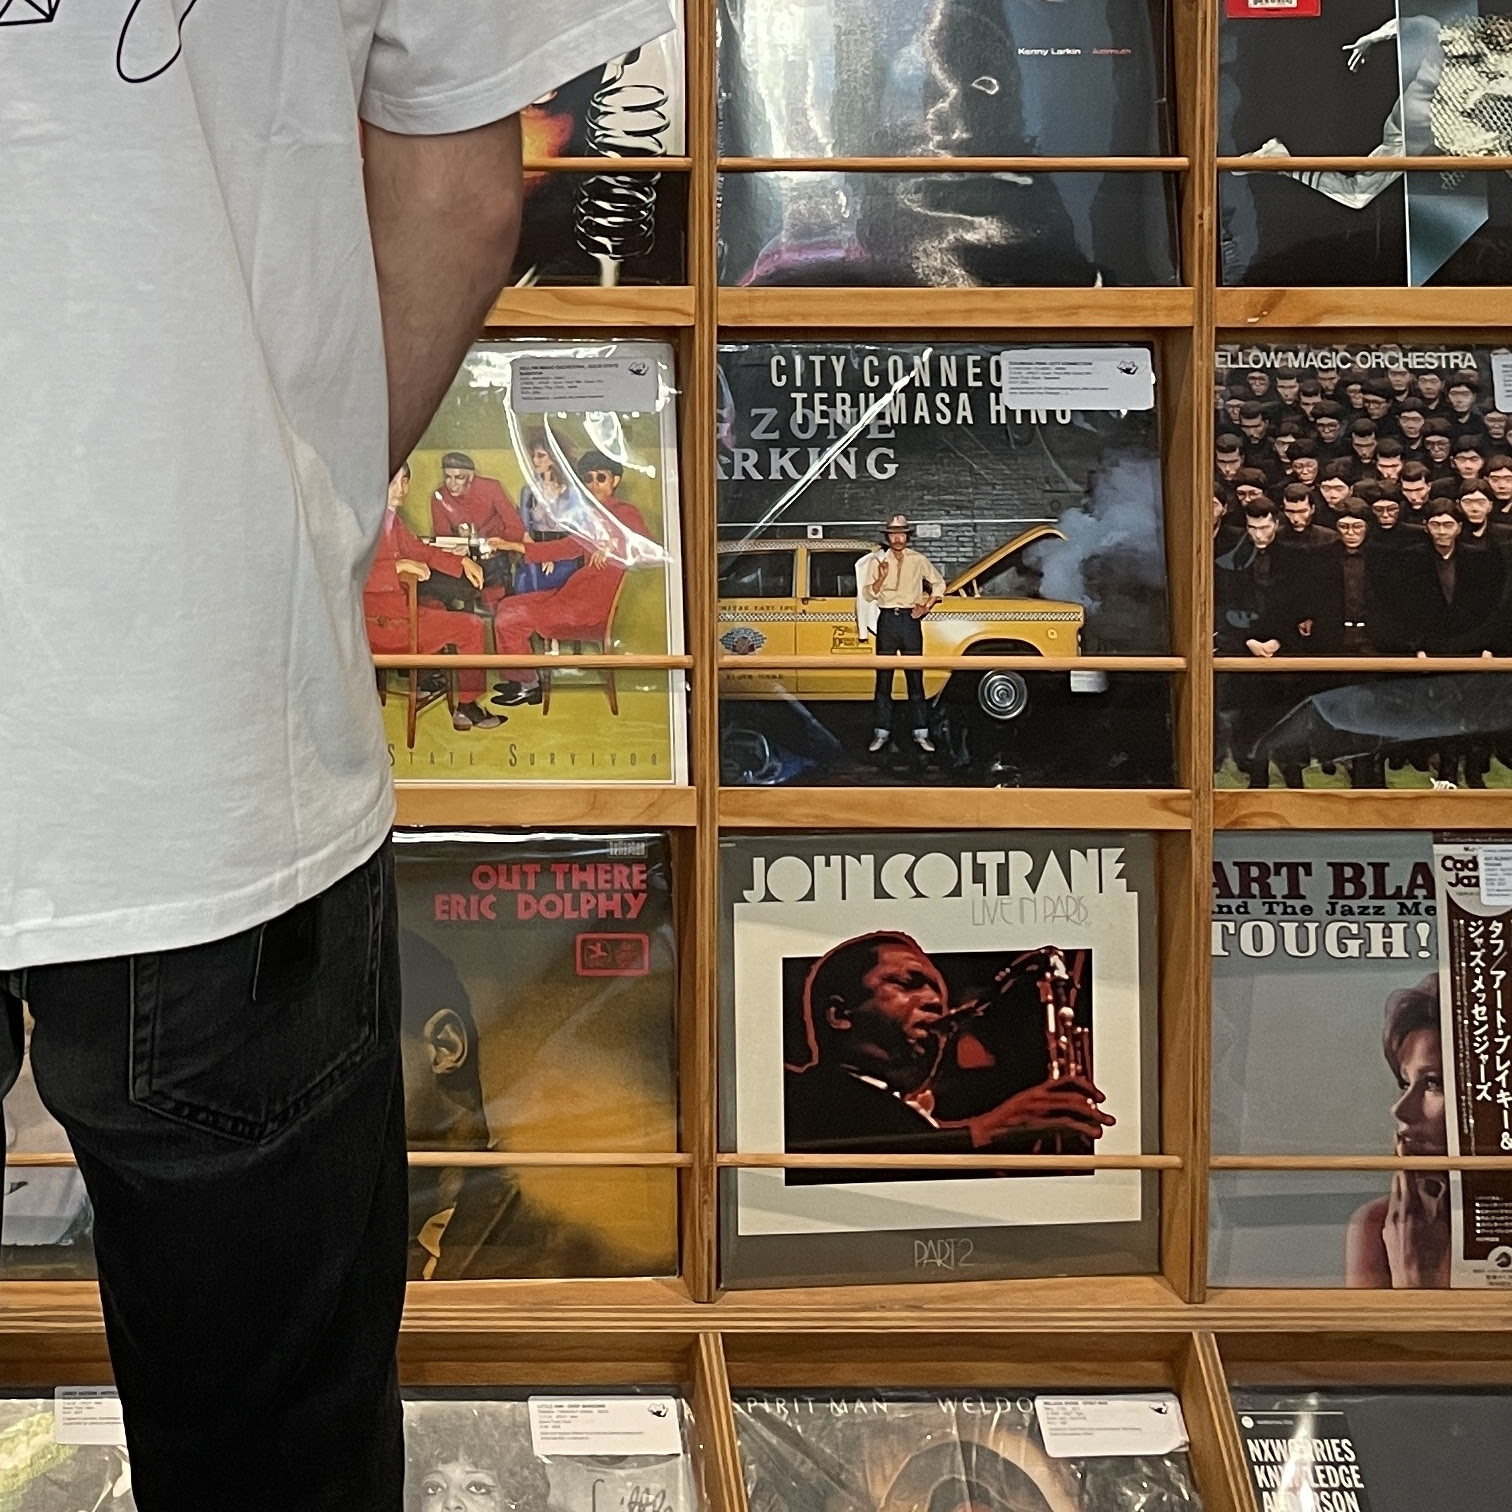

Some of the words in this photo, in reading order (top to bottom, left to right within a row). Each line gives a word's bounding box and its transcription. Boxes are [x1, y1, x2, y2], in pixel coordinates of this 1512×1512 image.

[1017, 48, 1048, 56] Kenny
[770, 355, 847, 387] CITY
[1297, 351, 1352, 369] MAGIC
[1355, 350, 1477, 369] ORCHESTRA
[471, 864, 541, 891] OUT
[550, 863, 647, 890] THERE
[742, 854, 875, 903] JOHN
[880, 847, 1127, 900] COLTRANE
[434, 893, 497, 921] ERIC
[517, 892, 648, 920] DOLPHY
[1262, 901, 1313, 916] The
[1326, 901, 1386, 916] Jazz
